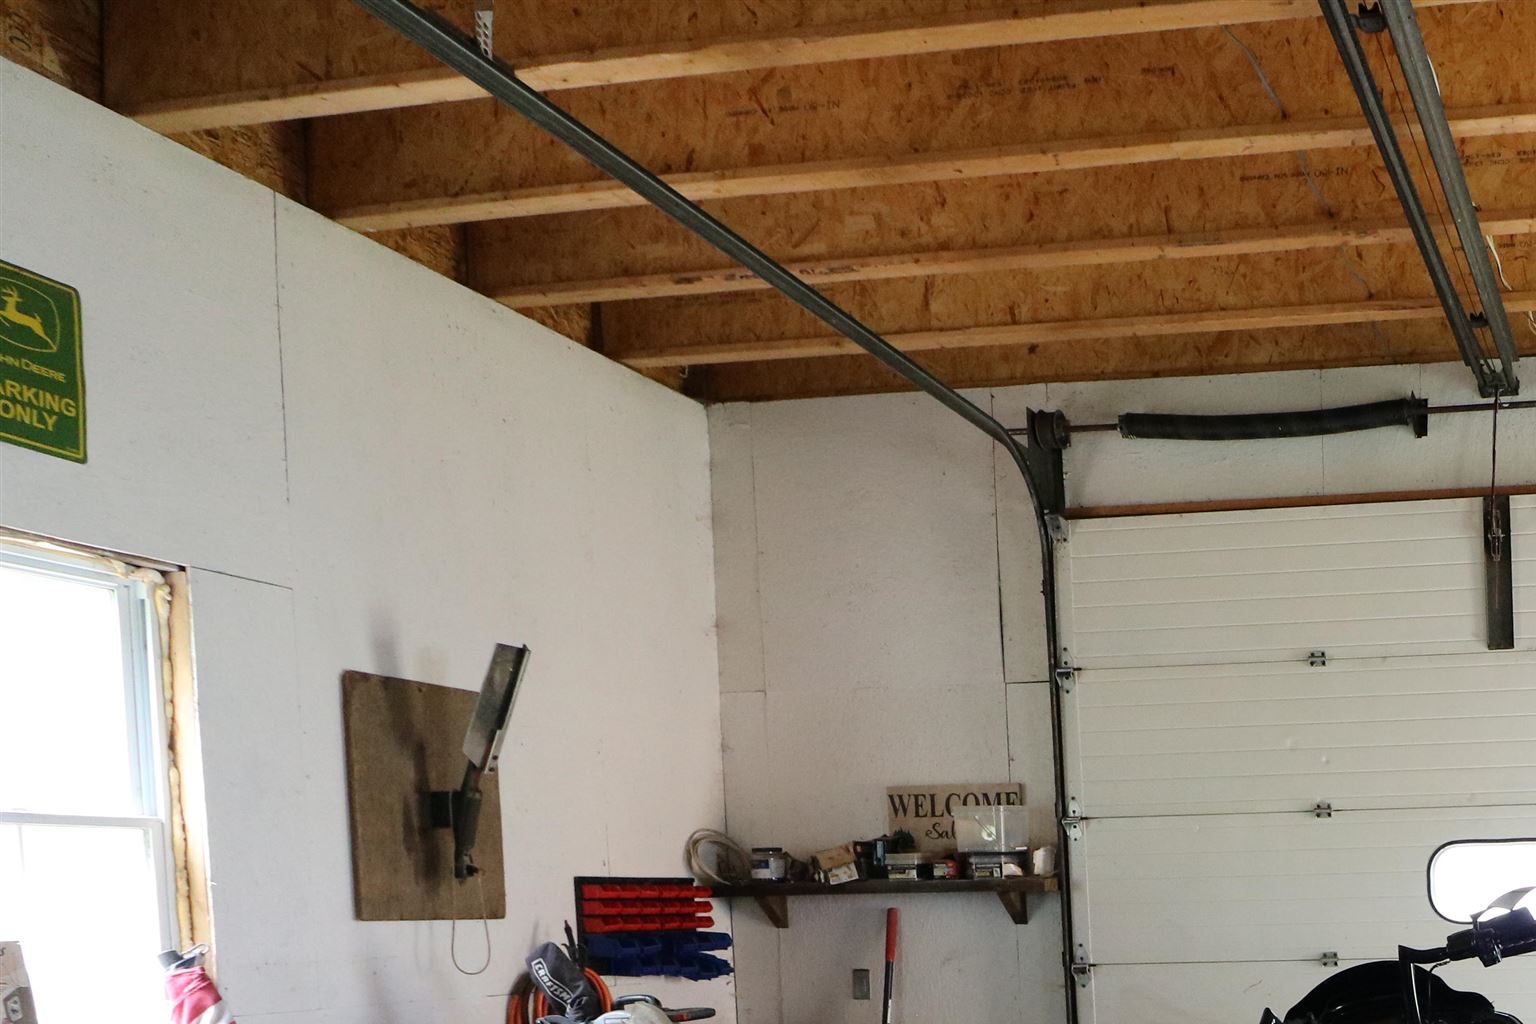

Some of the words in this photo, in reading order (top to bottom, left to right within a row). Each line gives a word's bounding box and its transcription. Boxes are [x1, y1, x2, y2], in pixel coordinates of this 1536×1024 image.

[21, 358, 66, 383] DEERE
[0, 399, 58, 431] ONLY
[535, 963, 573, 1004] CRAFTSM
